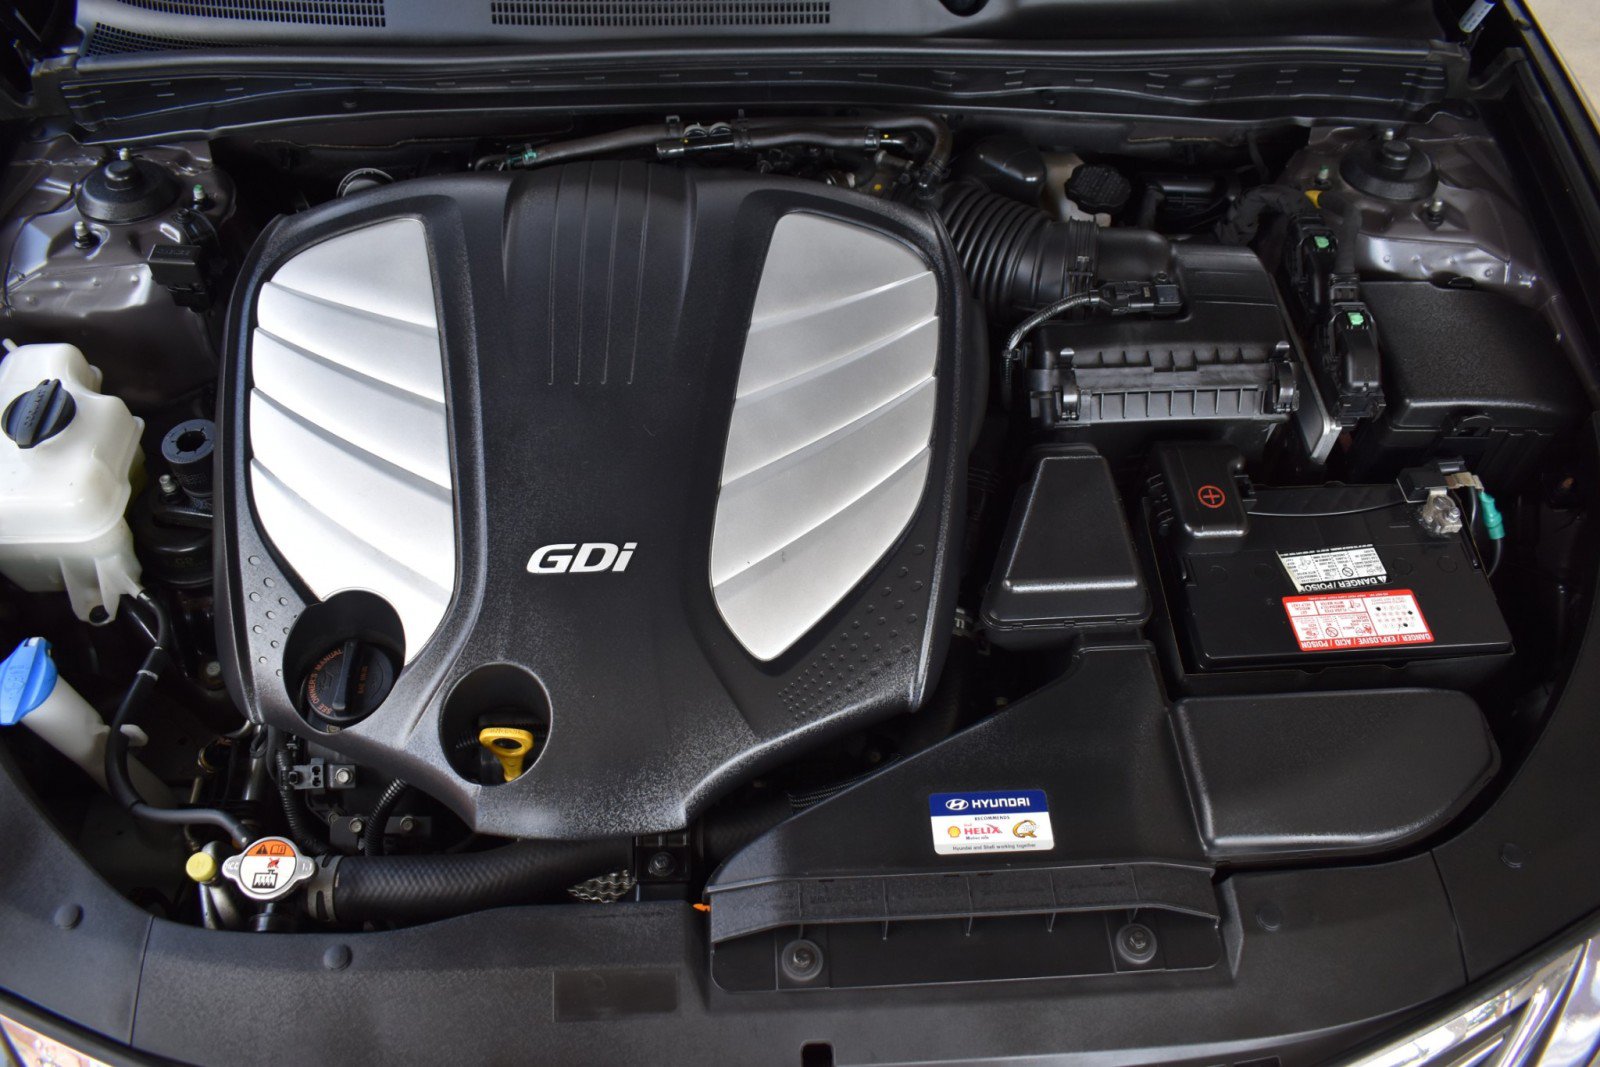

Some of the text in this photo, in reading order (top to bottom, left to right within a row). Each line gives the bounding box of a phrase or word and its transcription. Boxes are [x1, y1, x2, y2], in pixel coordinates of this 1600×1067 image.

[526, 542, 638, 574] GDi
[1338, 577, 1378, 588] DANGER
[1359, 636, 1396, 644] EXPLOSIVE
[1401, 633, 1431, 642] DANGER
[318, 704, 333, 714] SEE
[972, 798, 1030, 808] HYUNDAI
[964, 825, 1002, 835] HELIX
